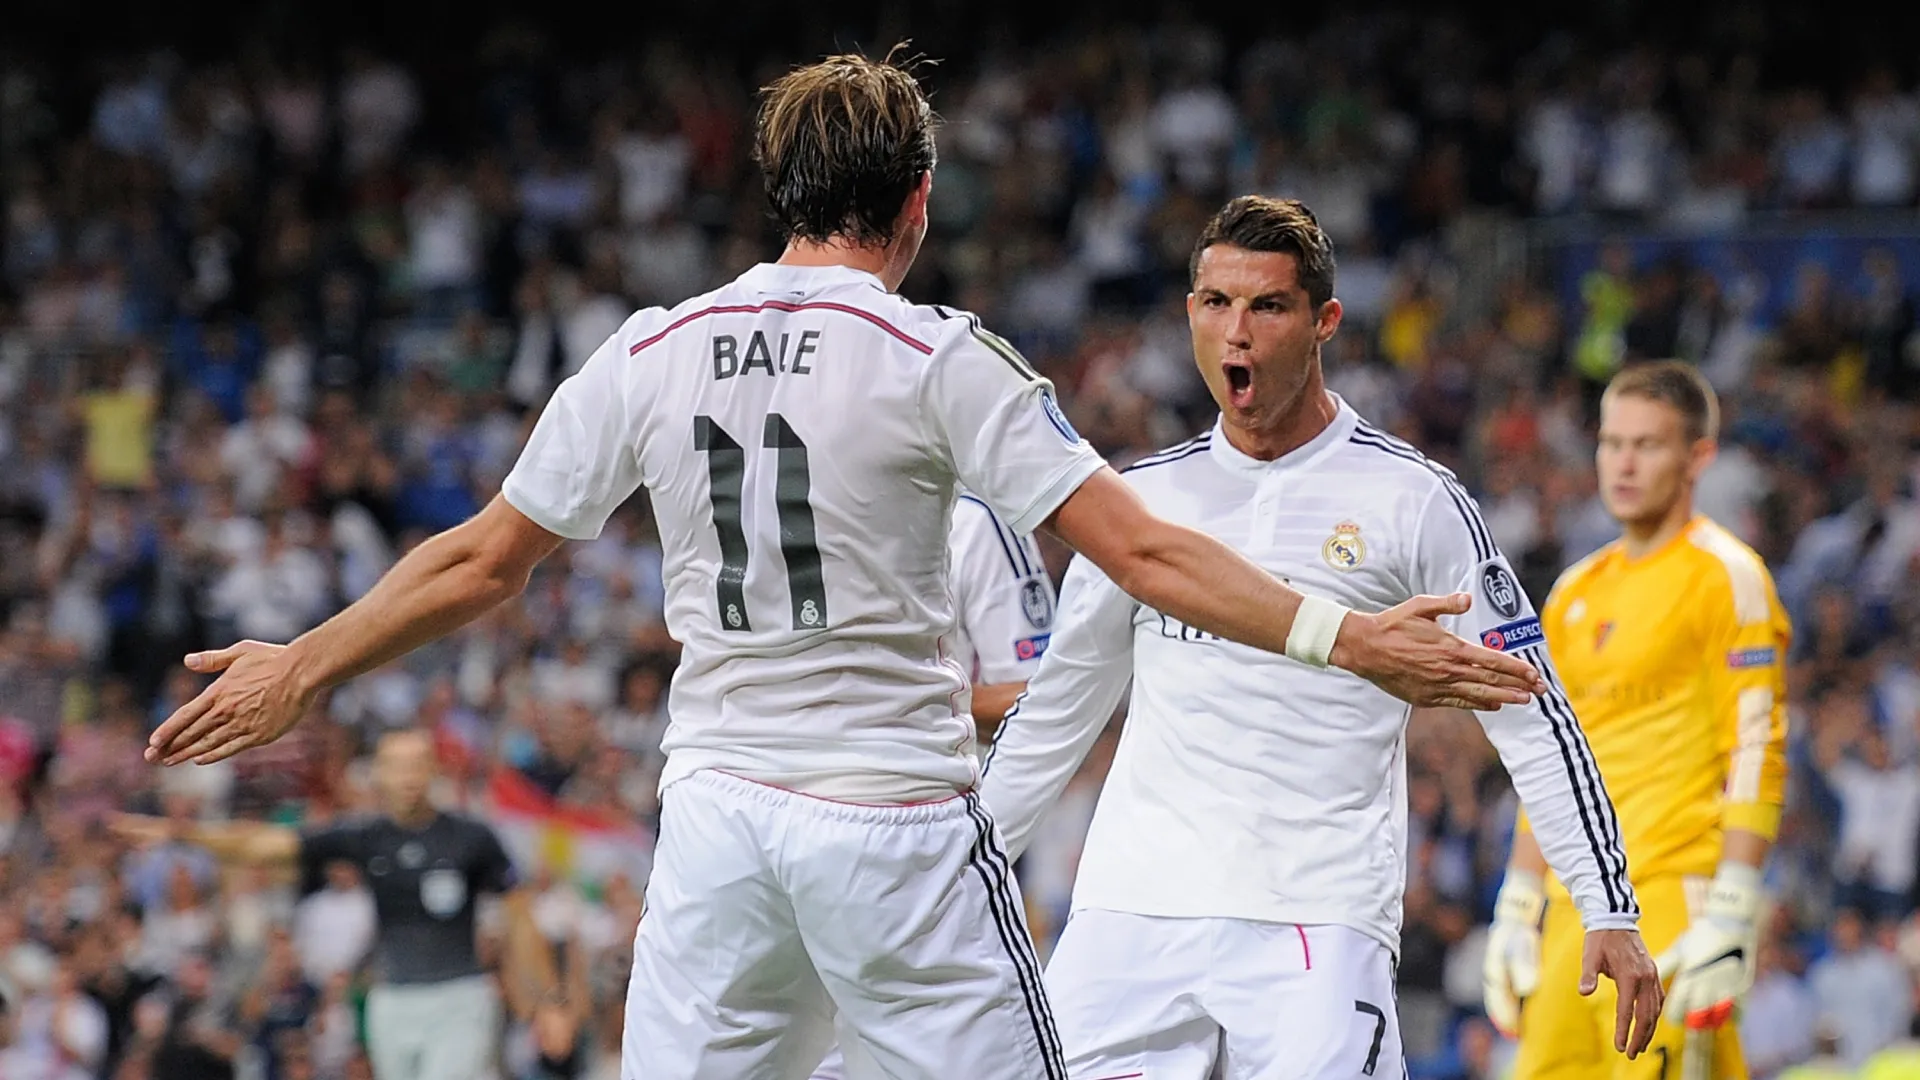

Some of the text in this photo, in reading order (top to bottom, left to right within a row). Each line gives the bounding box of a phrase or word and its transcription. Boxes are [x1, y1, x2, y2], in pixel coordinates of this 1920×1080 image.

[712, 329, 821, 381] BALE
[693, 412, 828, 632] 11
[1494, 588, 1512, 607] 10
[1503, 622, 1541, 643] RESPECT
[1354, 999, 1387, 1077] 7
